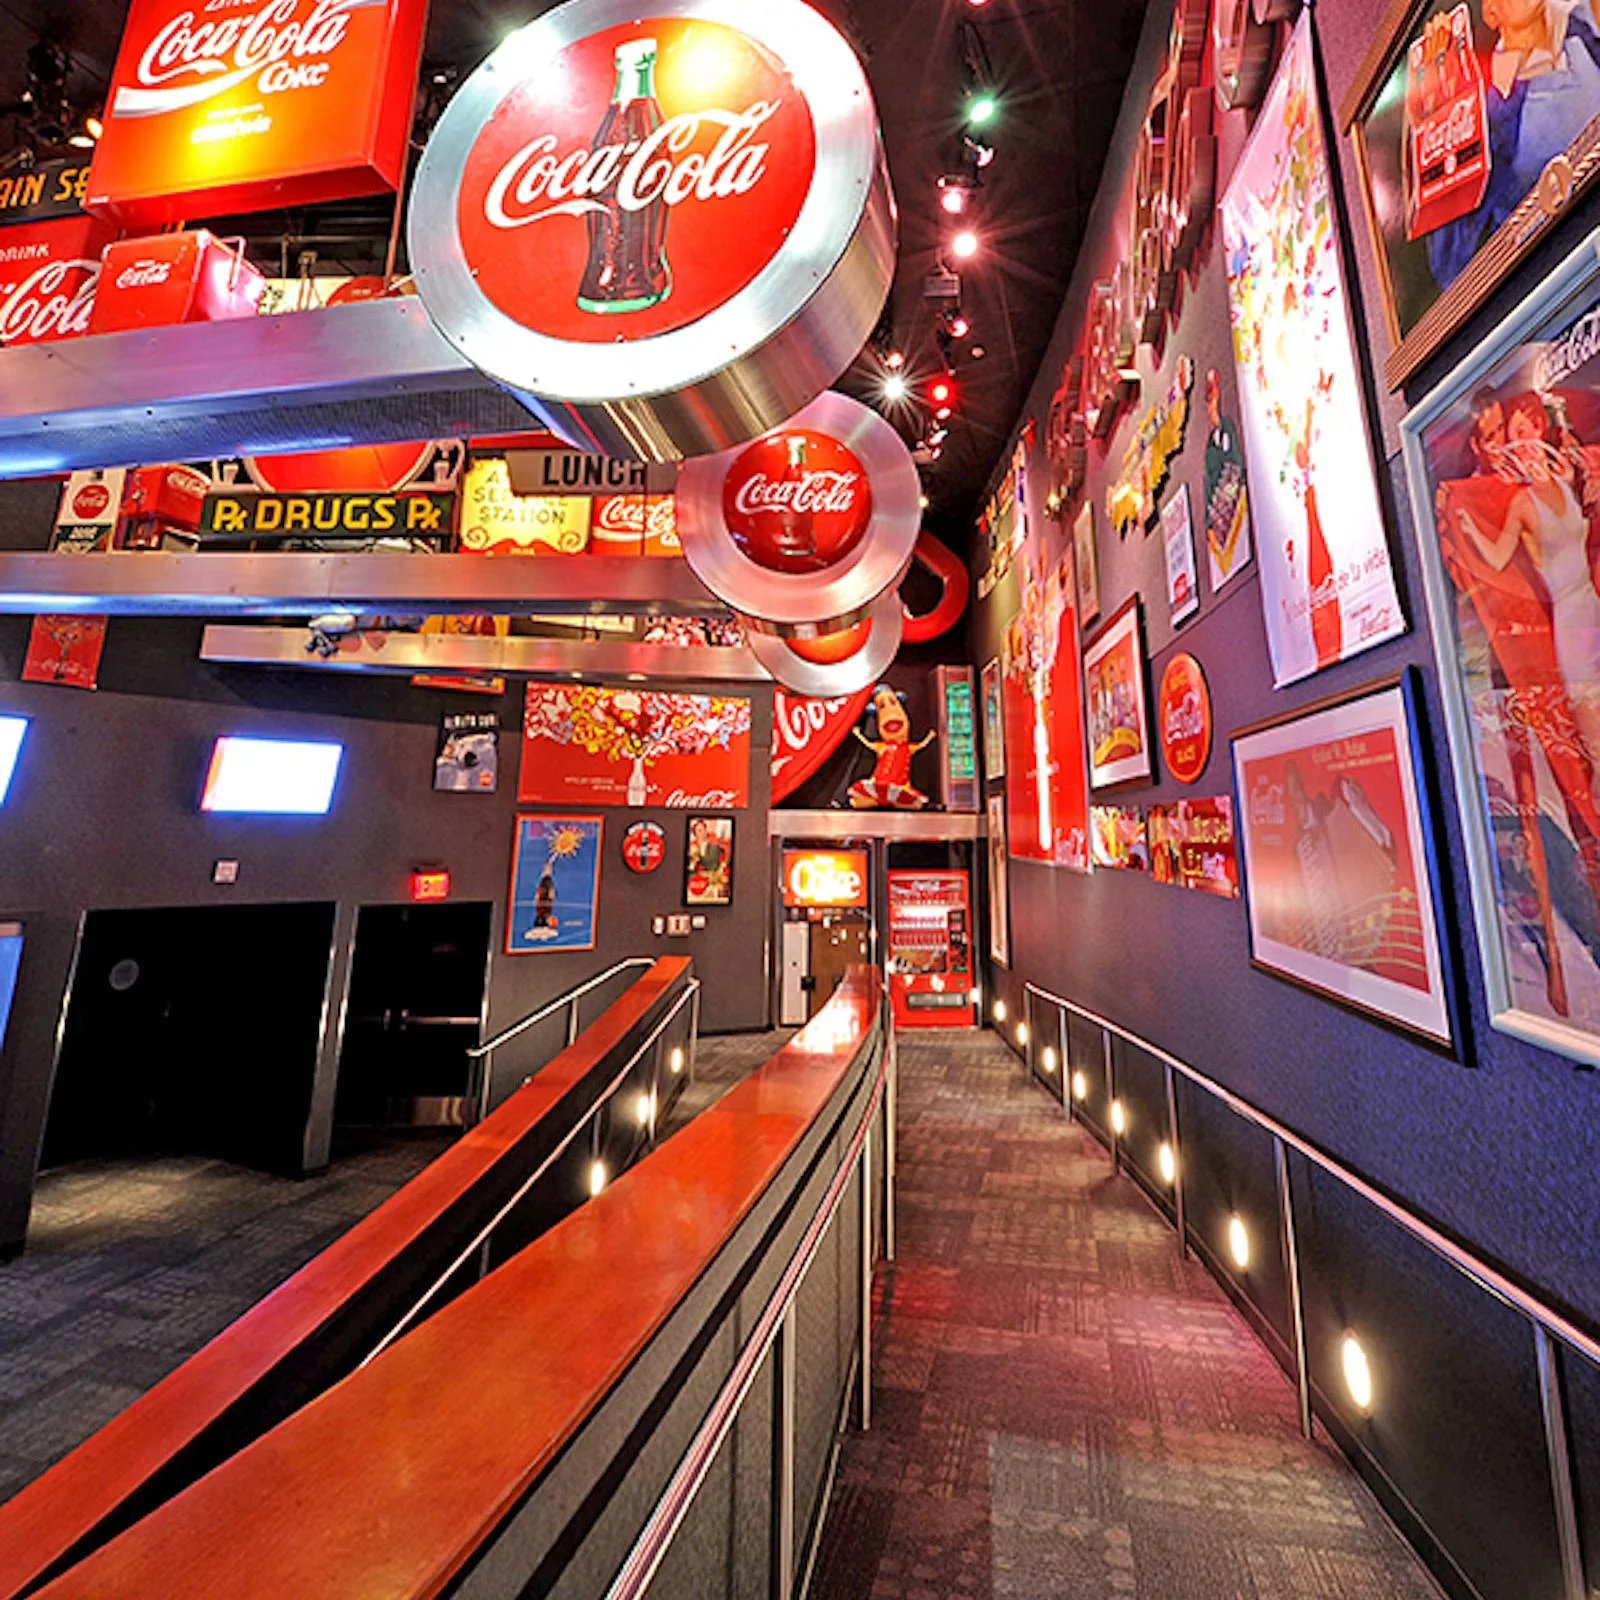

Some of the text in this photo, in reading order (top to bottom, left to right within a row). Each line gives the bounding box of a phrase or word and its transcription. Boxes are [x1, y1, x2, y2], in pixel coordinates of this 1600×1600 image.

[138, 0, 350, 85] Coca-Cola
[258, 61, 330, 93] Coke
[484, 99, 782, 228] Coca-Cola
[542, 455, 645, 486] LUNCH
[735, 470, 860, 516] Coca-Cola
[254, 498, 397, 530] DRUGS
[479, 505, 566, 524] STATION
